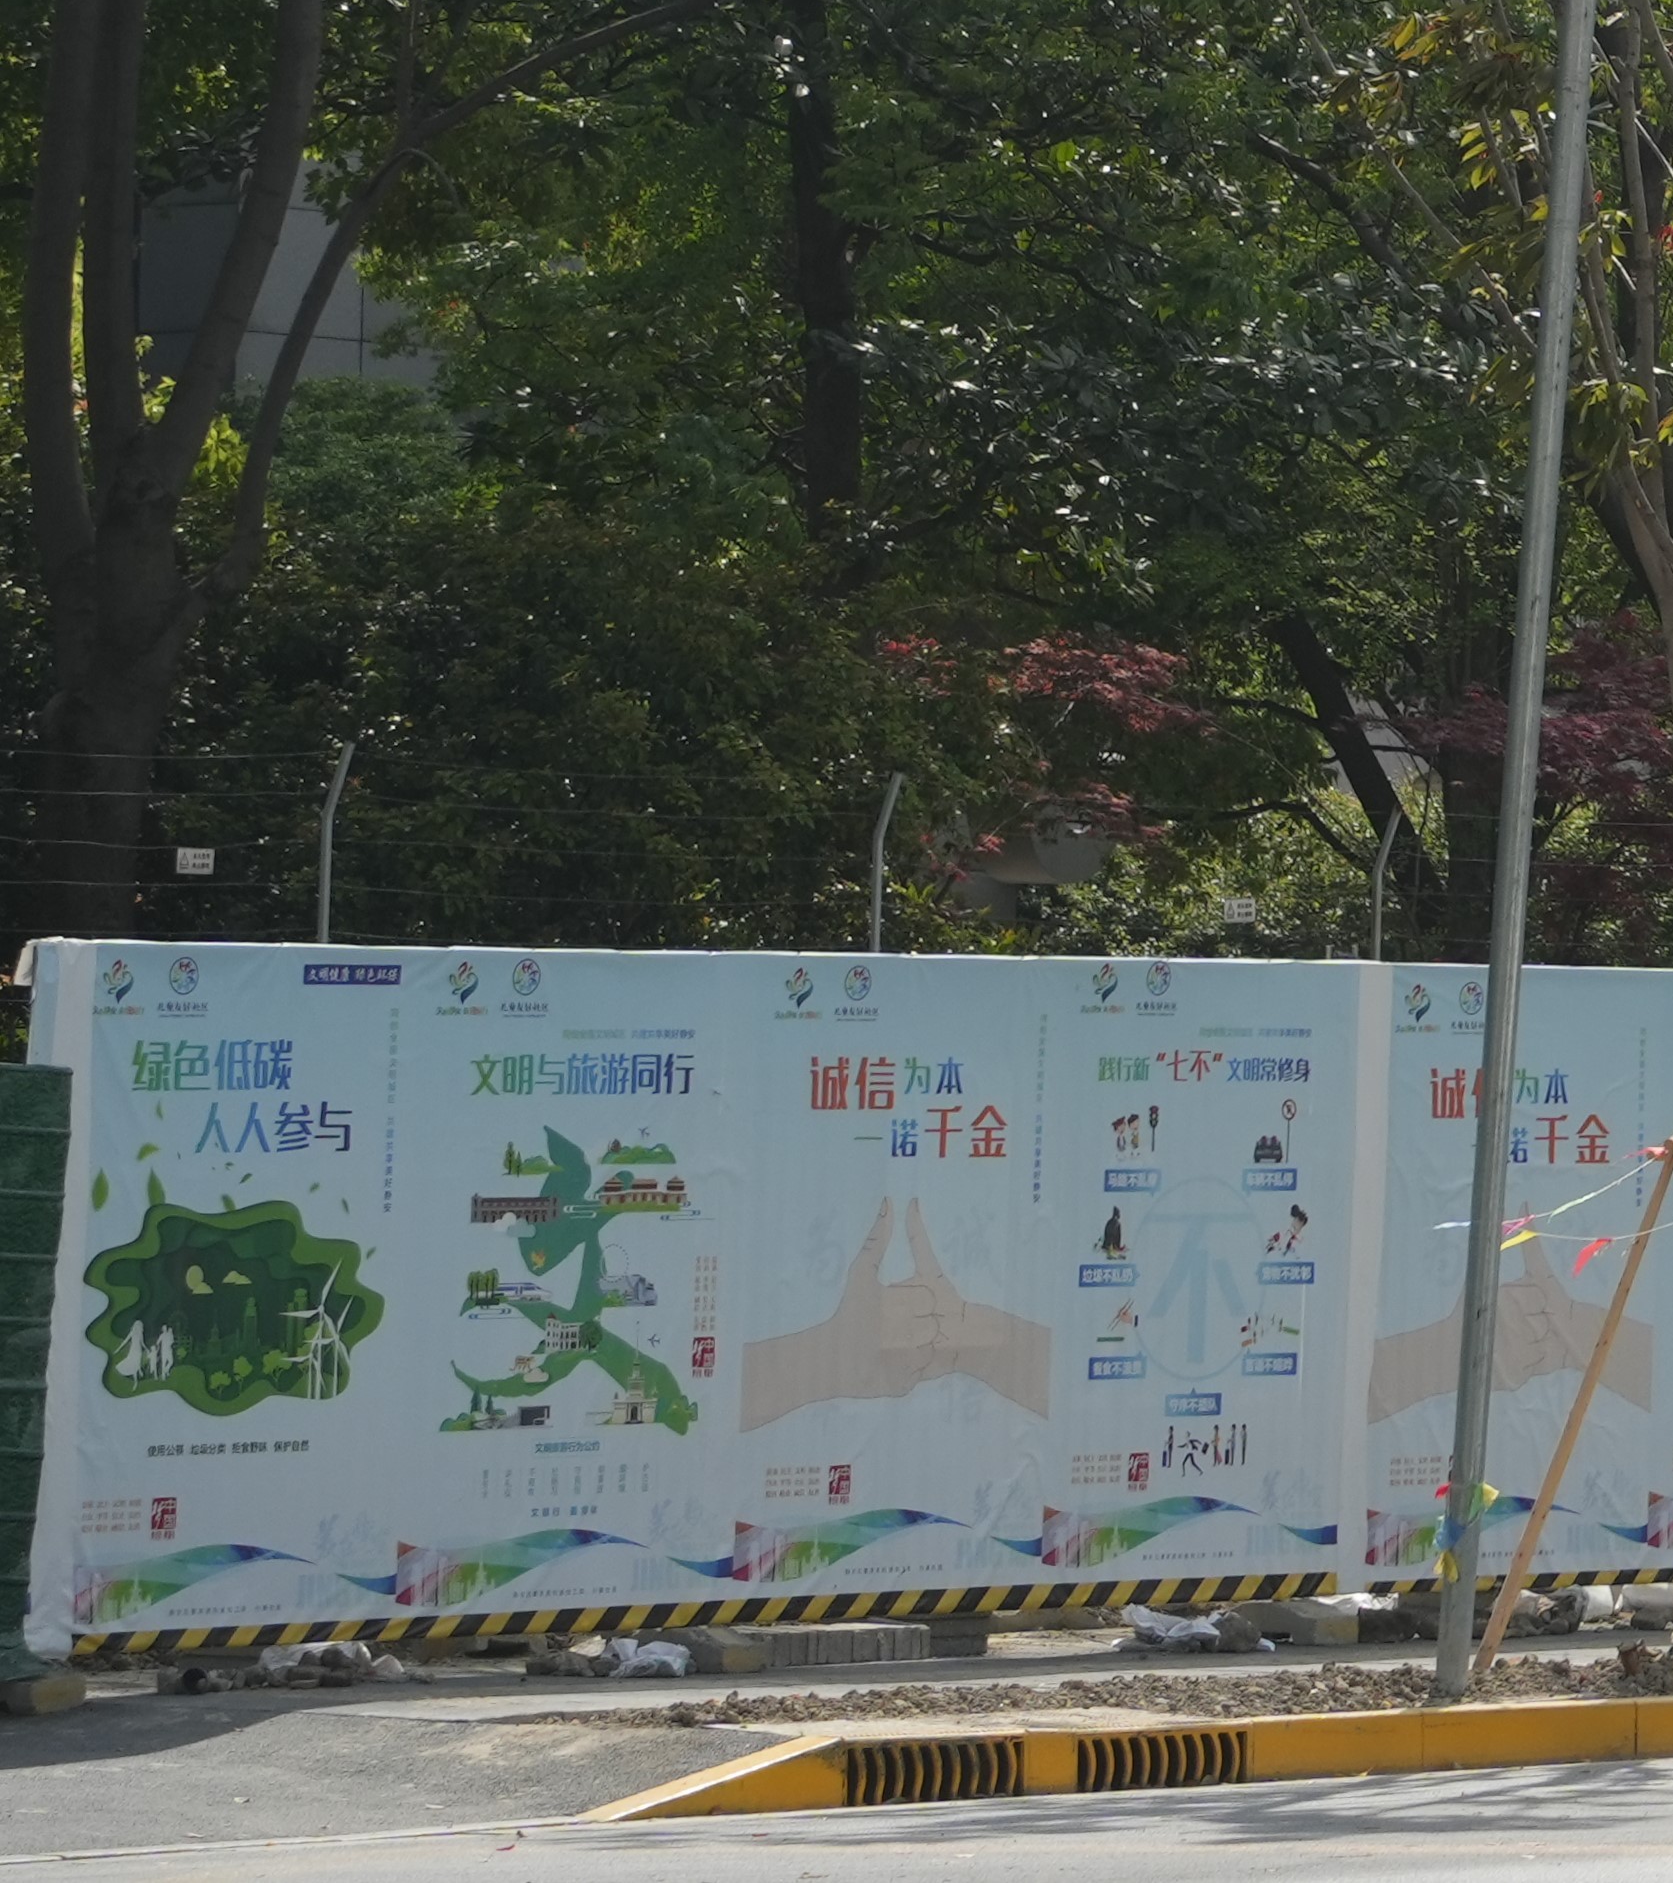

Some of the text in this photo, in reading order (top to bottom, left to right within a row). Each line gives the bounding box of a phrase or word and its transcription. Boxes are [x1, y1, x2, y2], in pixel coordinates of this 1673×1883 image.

[132, 1039, 293, 1091] 绿色低碳
[470, 1053, 695, 1096] 文明与旅游同行
[810, 1056, 964, 1110] 诚信为本
[195, 1101, 352, 1153] 人人参与
[854, 1105, 1008, 1158] 一诺千金
